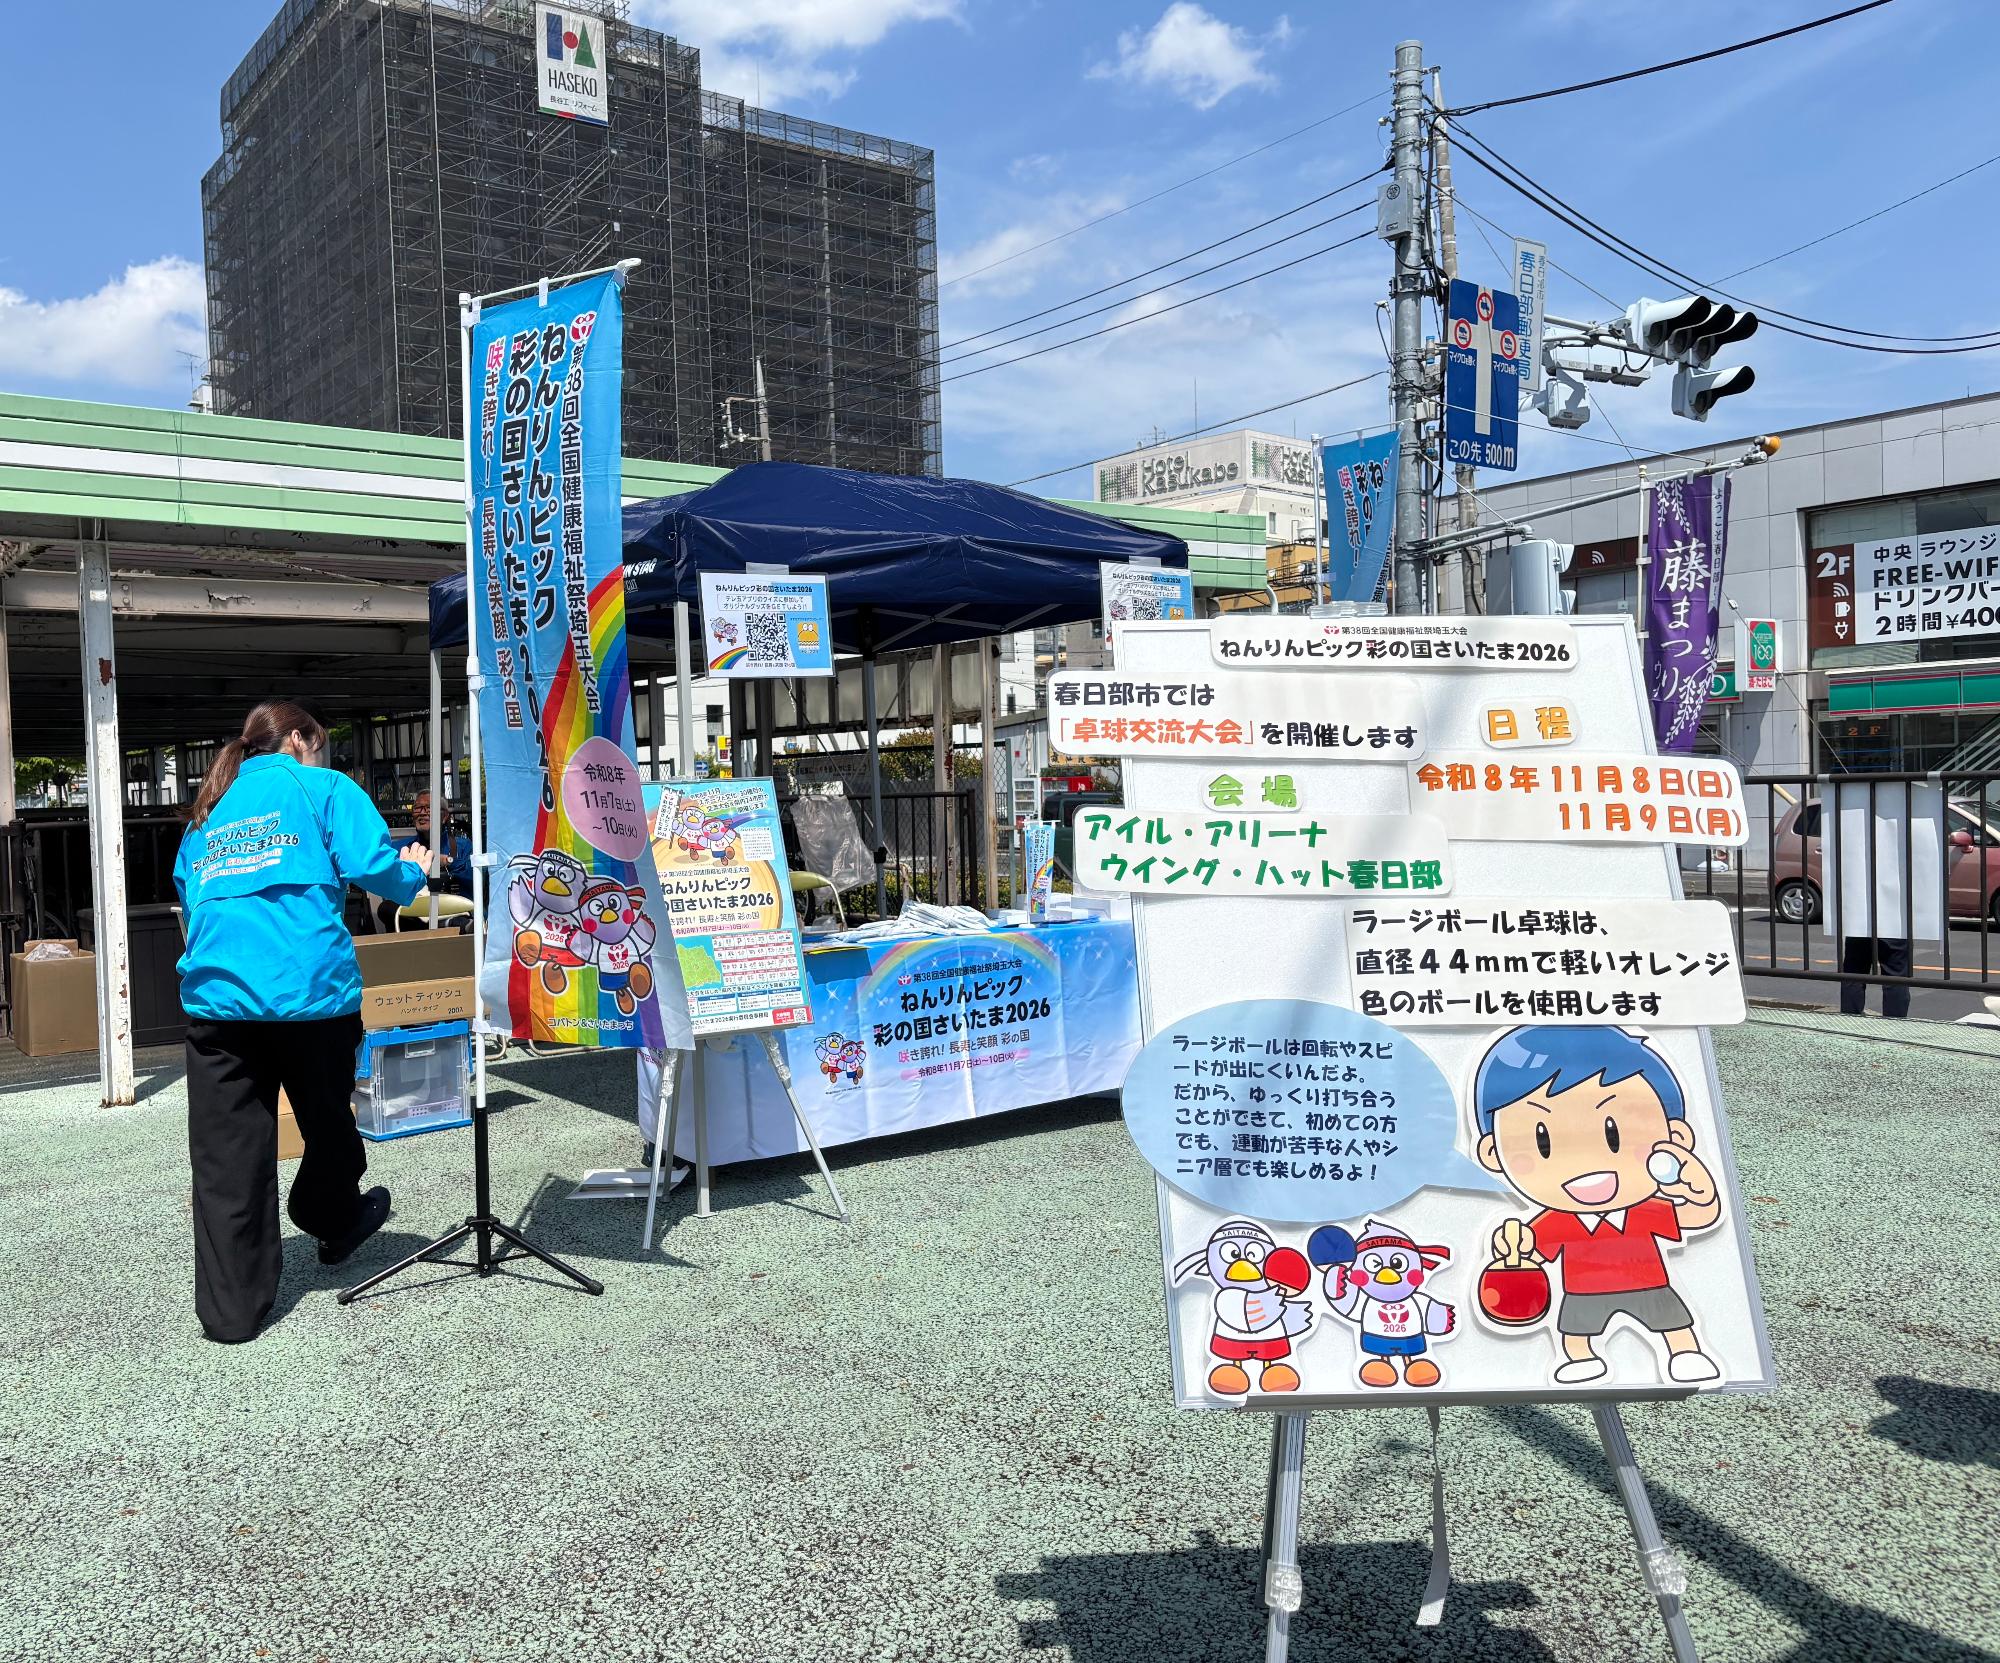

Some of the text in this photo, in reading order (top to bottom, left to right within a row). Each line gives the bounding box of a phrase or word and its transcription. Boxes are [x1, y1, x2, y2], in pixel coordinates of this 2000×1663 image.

[548, 68, 598, 97] HASEKO
[1142, 450, 1190, 476] Hotel
[1450, 440, 1514, 468] この先 500m
[528, 324, 566, 631] ねんりんピック
[1142, 462, 1239, 497] Kasukabe
[1353, 463, 1373, 538] 彩の
[561, 344, 601, 714] 第38回全国健康福祉祭埼玉大会
[1873, 532, 1997, 563] 中央 ラウンジ
[501, 328, 555, 812] 彩の国さいたま2026
[1816, 551, 1851, 578] 2F
[715, 584, 813, 593] ねんりんピック彩の国さいたま2026
[481, 499, 508, 641] 長寿と笑顔
[496, 649, 523, 730] 彩の国
[1659, 538, 1711, 700] 藤まつり
[1875, 611, 1942, 636] 2時間
[1341, 625, 1468, 636] 第38回全国健康福祉祭埼玉大会
[1220, 638, 1570, 662] ねんりんピック彩の国さいたま2026
[1054, 682, 1215, 707] 春日部市では
[1060, 717, 1418, 749] 「卓球交流大会」を開催します
[1487, 706, 1572, 741] 日程
[583, 763, 626, 785] 令和8年
[1416, 763, 1733, 799] 令和8年11月8日(日)
[580, 791, 636, 813] 11月7日(土)
[1208, 773, 1297, 808] 会場
[592, 817, 638, 838] ~10日(火)
[1084, 814, 1328, 849] アイル・アリーナ
[1559, 802, 1742, 837] 11月9日(月)
[1100, 853, 1441, 893] ウイング・ハット春日部
[661, 877, 751, 896] ねんりんピック
[1352, 908, 1609, 936] ラージボール卓球は、
[545, 932, 565, 943] 2026
[612, 961, 630, 970] 2026
[913, 958, 1023, 983] 第38回全国健康福祉祭埼玉大会
[1356, 948, 1731, 977] 直径44mmで軽いオレンジ
[375, 989, 462, 1007] ウェット ティッシュ
[901, 975, 1024, 1013] ねんりんピック
[1359, 989, 1662, 1018] 色のボールを使用します
[549, 1017, 634, 1031] コバトン&さいたまっち
[872, 997, 1051, 1048] 彩の国さいたま2026
[898, 1029, 1030, 1063] 咲き誇れ！ 長寿と笑顔 彩の国
[1172, 1035, 1393, 1060] ラージボールは回転やスピ
[1173, 1059, 1367, 1083] ードが出にくいんだよ。
[1174, 1083, 1396, 1108] だから、ゆっくり打ち合う
[1175, 1108, 1398, 1134] ことができて、初めての方
[1175, 1132, 1399, 1157] でも、運動が苦手な人やシ
[1176, 1157, 1377, 1181] ニア層でも楽しめるよ！
[1222, 1230, 1259, 1238] SAITAMA
[1365, 1237, 1404, 1248] SAITAMA
[1383, 1324, 1407, 1333] 2026
